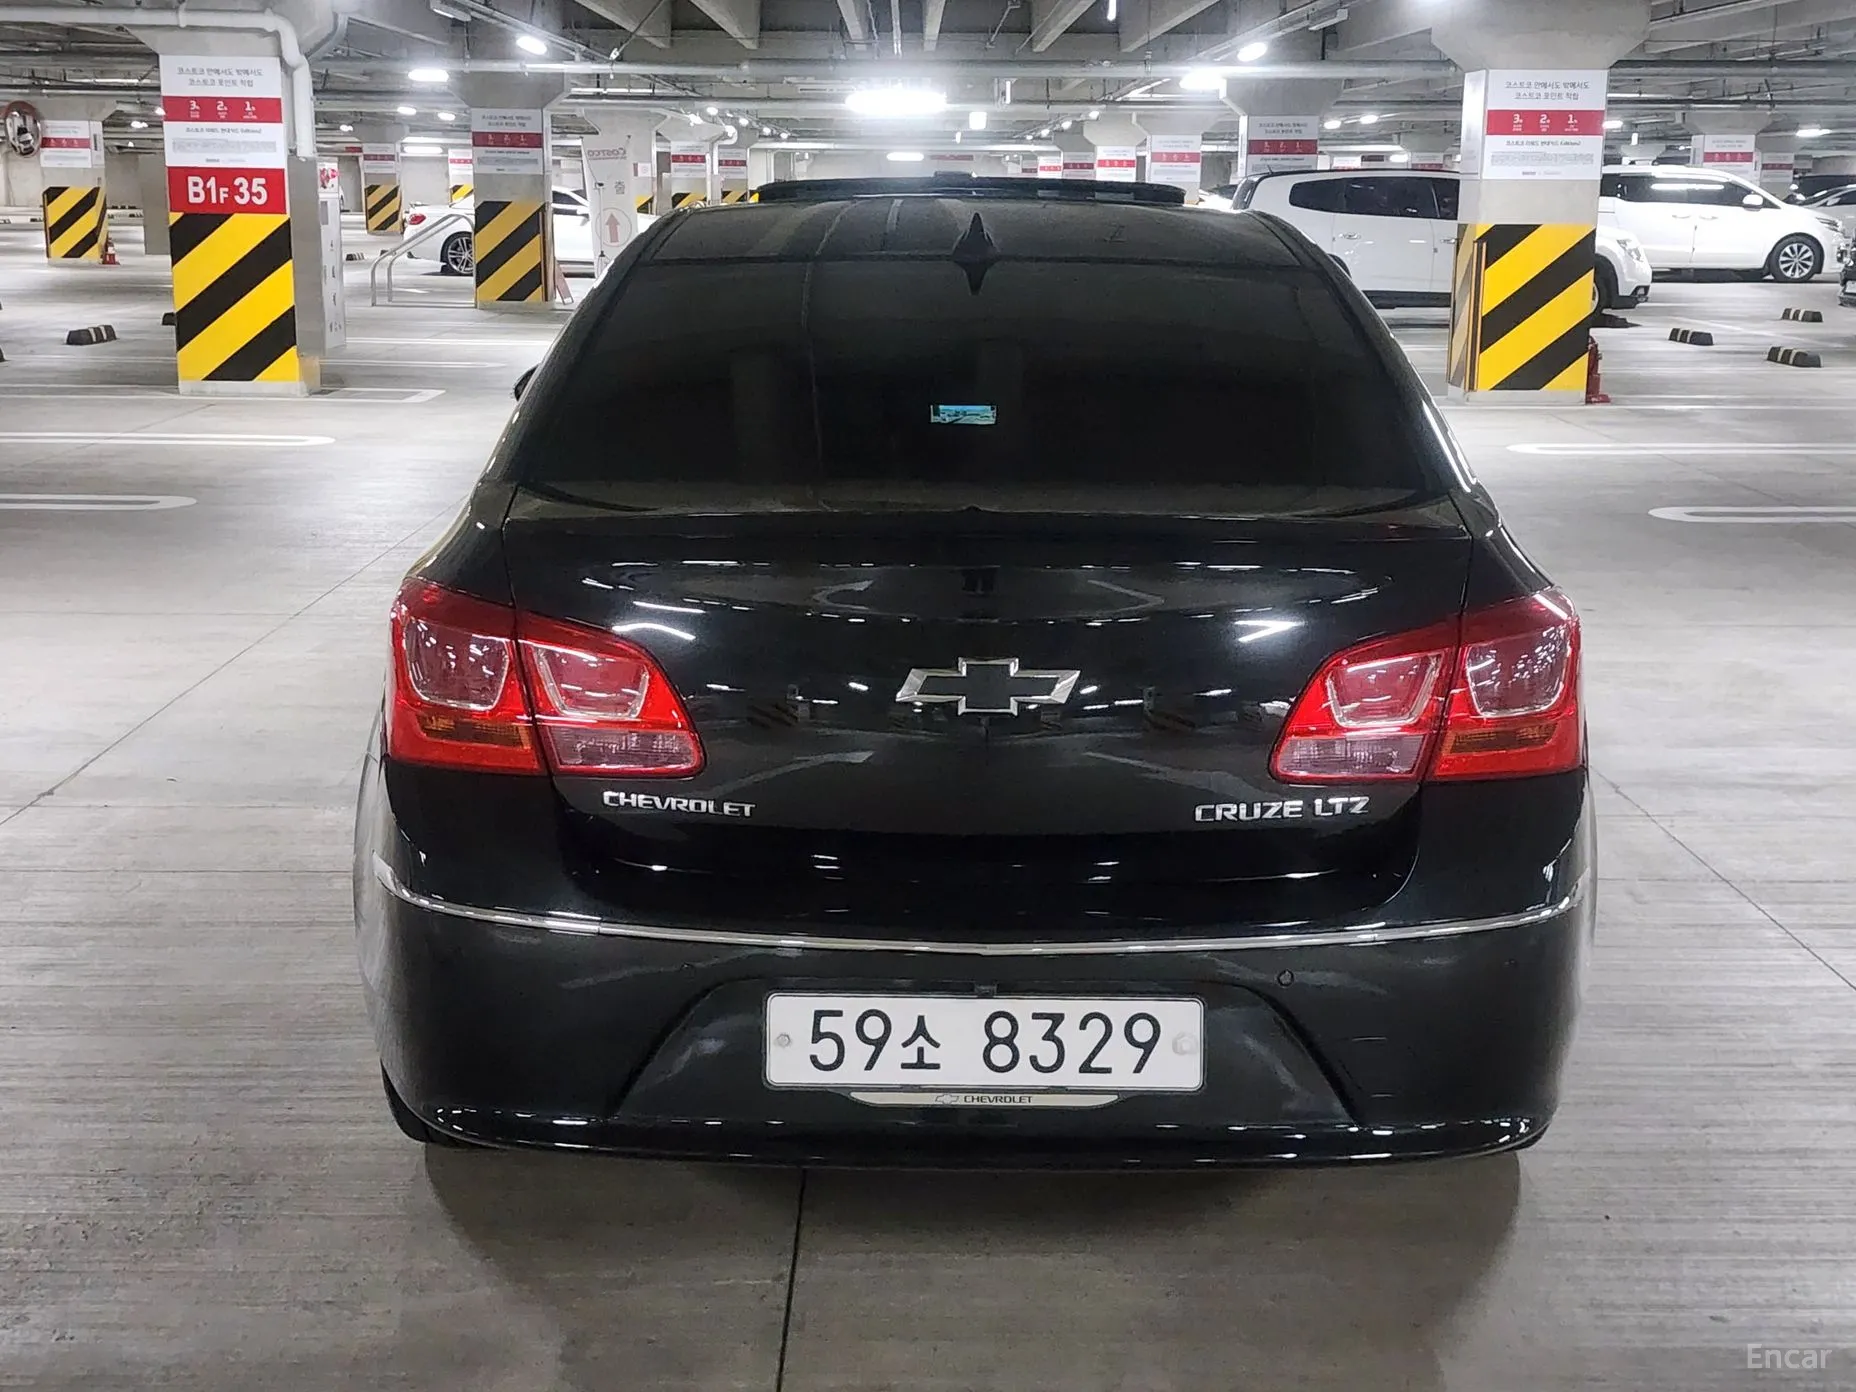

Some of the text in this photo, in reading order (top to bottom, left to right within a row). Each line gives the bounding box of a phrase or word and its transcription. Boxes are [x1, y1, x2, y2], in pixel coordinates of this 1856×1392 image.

[187, 175, 268, 205] B1F 35
[603, 790, 756, 817] CHEVROLET
[1194, 796, 1370, 822] CRUZE LTZ
[809, 1008, 1162, 1074] 59소 8329
[963, 1095, 1033, 1104] CHEVROLET
